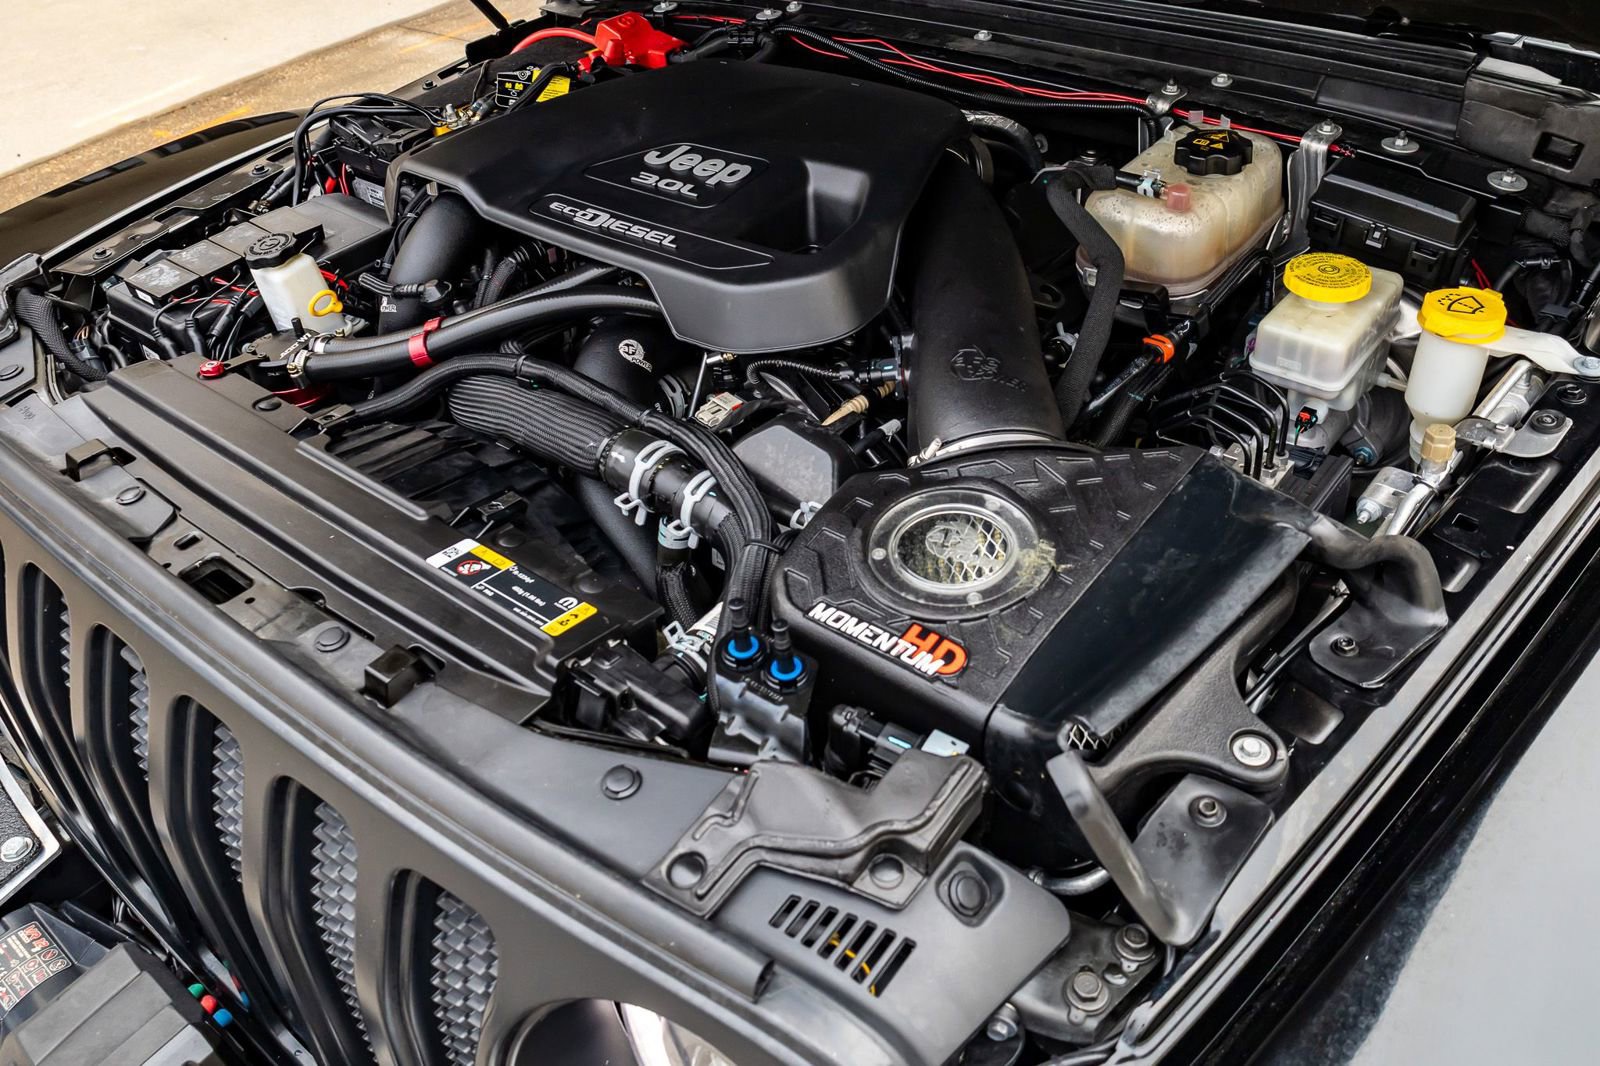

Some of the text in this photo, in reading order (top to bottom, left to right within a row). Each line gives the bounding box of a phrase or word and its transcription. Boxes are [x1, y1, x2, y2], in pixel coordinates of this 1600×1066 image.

[631, 171, 698, 198] 3.0L
[644, 145, 752, 187] Jeep
[807, 602, 968, 676] MOMENTUM HD
